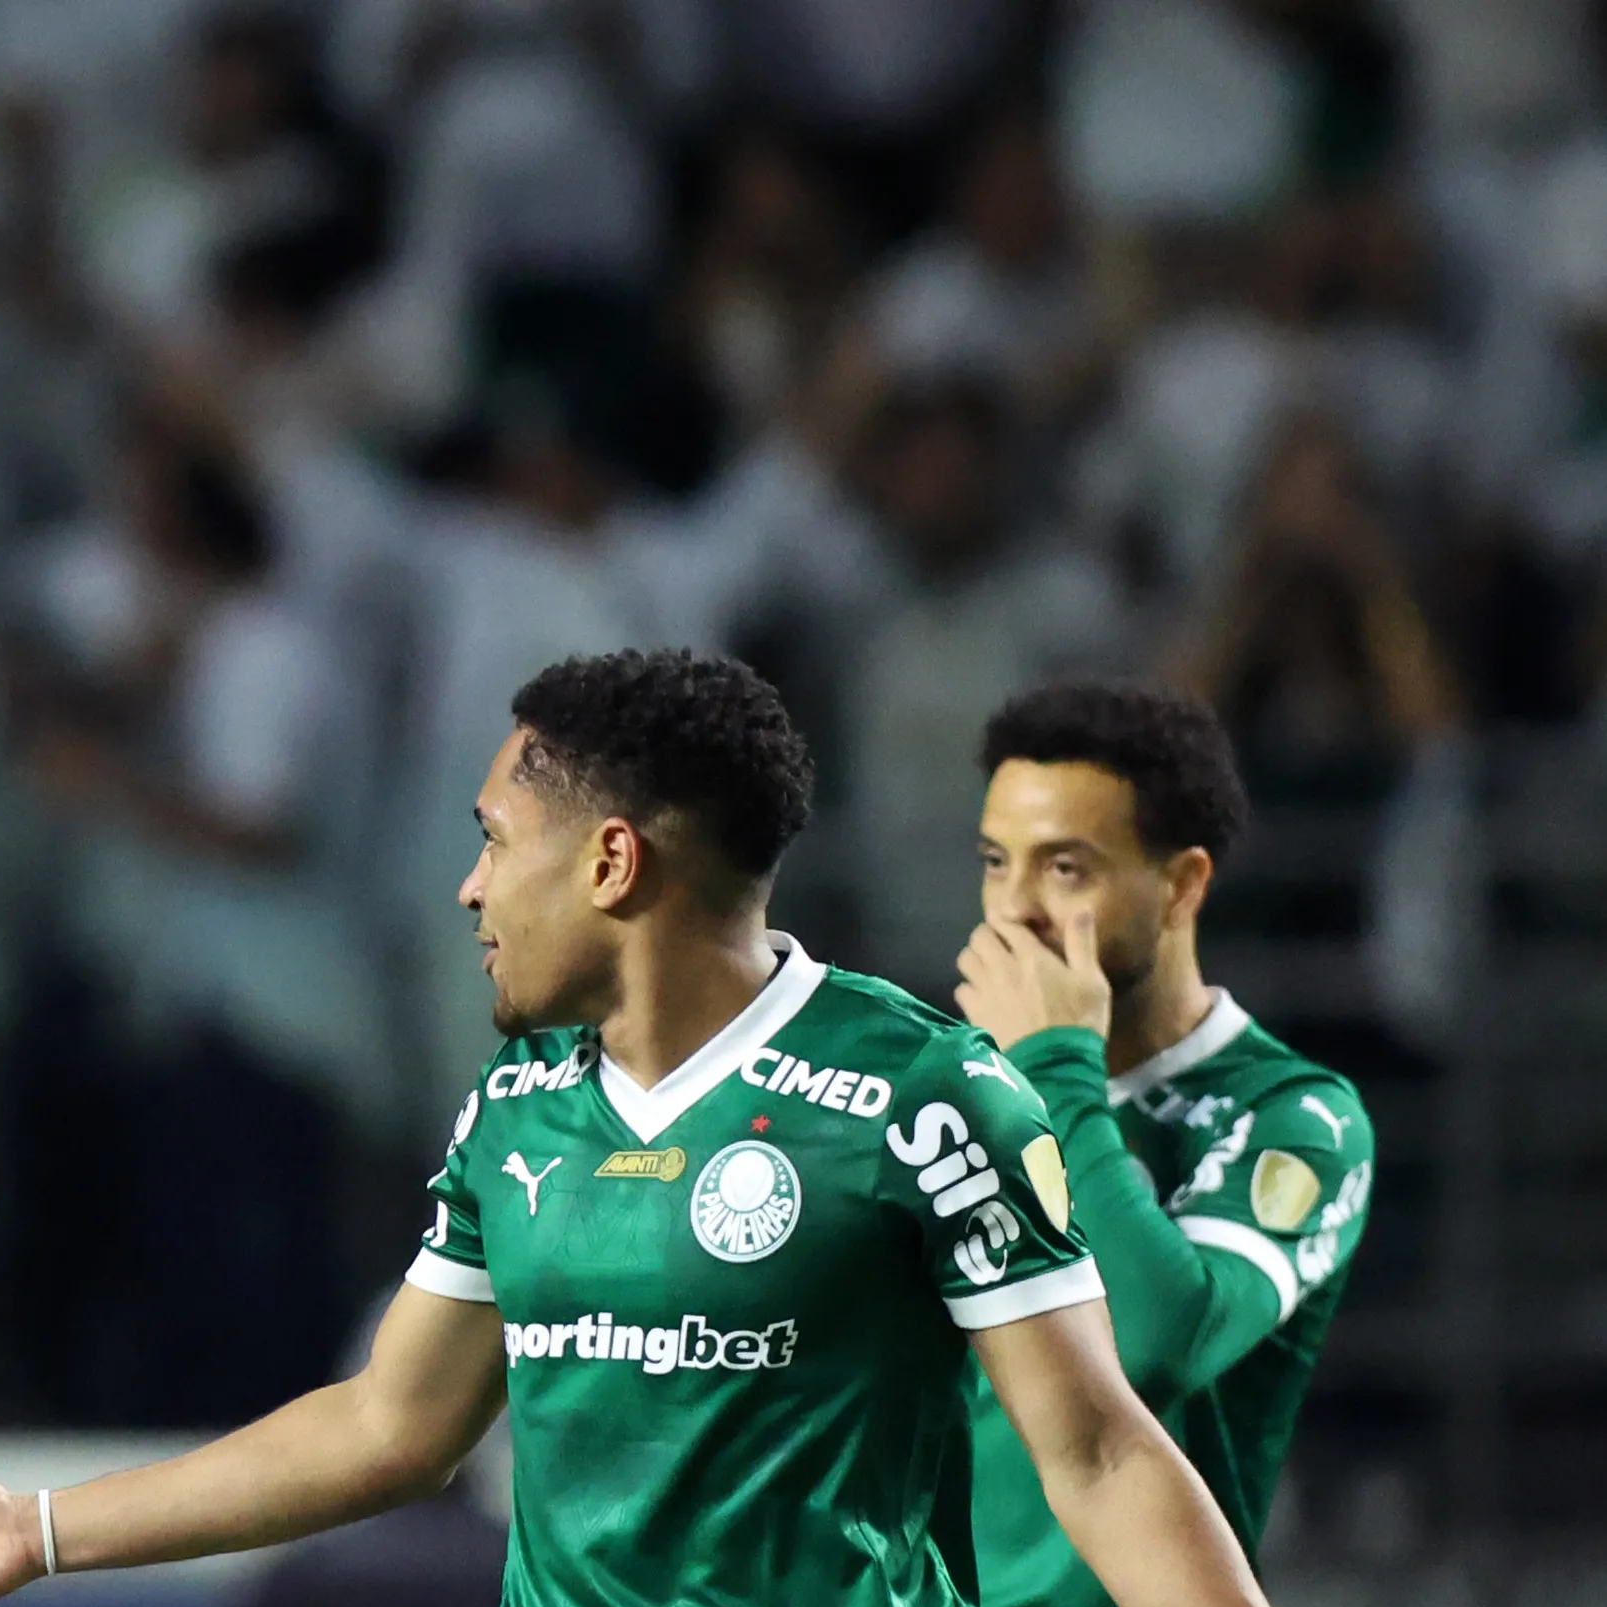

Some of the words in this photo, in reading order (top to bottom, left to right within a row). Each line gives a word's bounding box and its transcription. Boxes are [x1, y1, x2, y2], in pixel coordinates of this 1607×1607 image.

[739, 1047, 892, 1118] CIMED
[603, 1155, 660, 1174] AVANTI
[698, 1191, 794, 1254] PALMEIRAS
